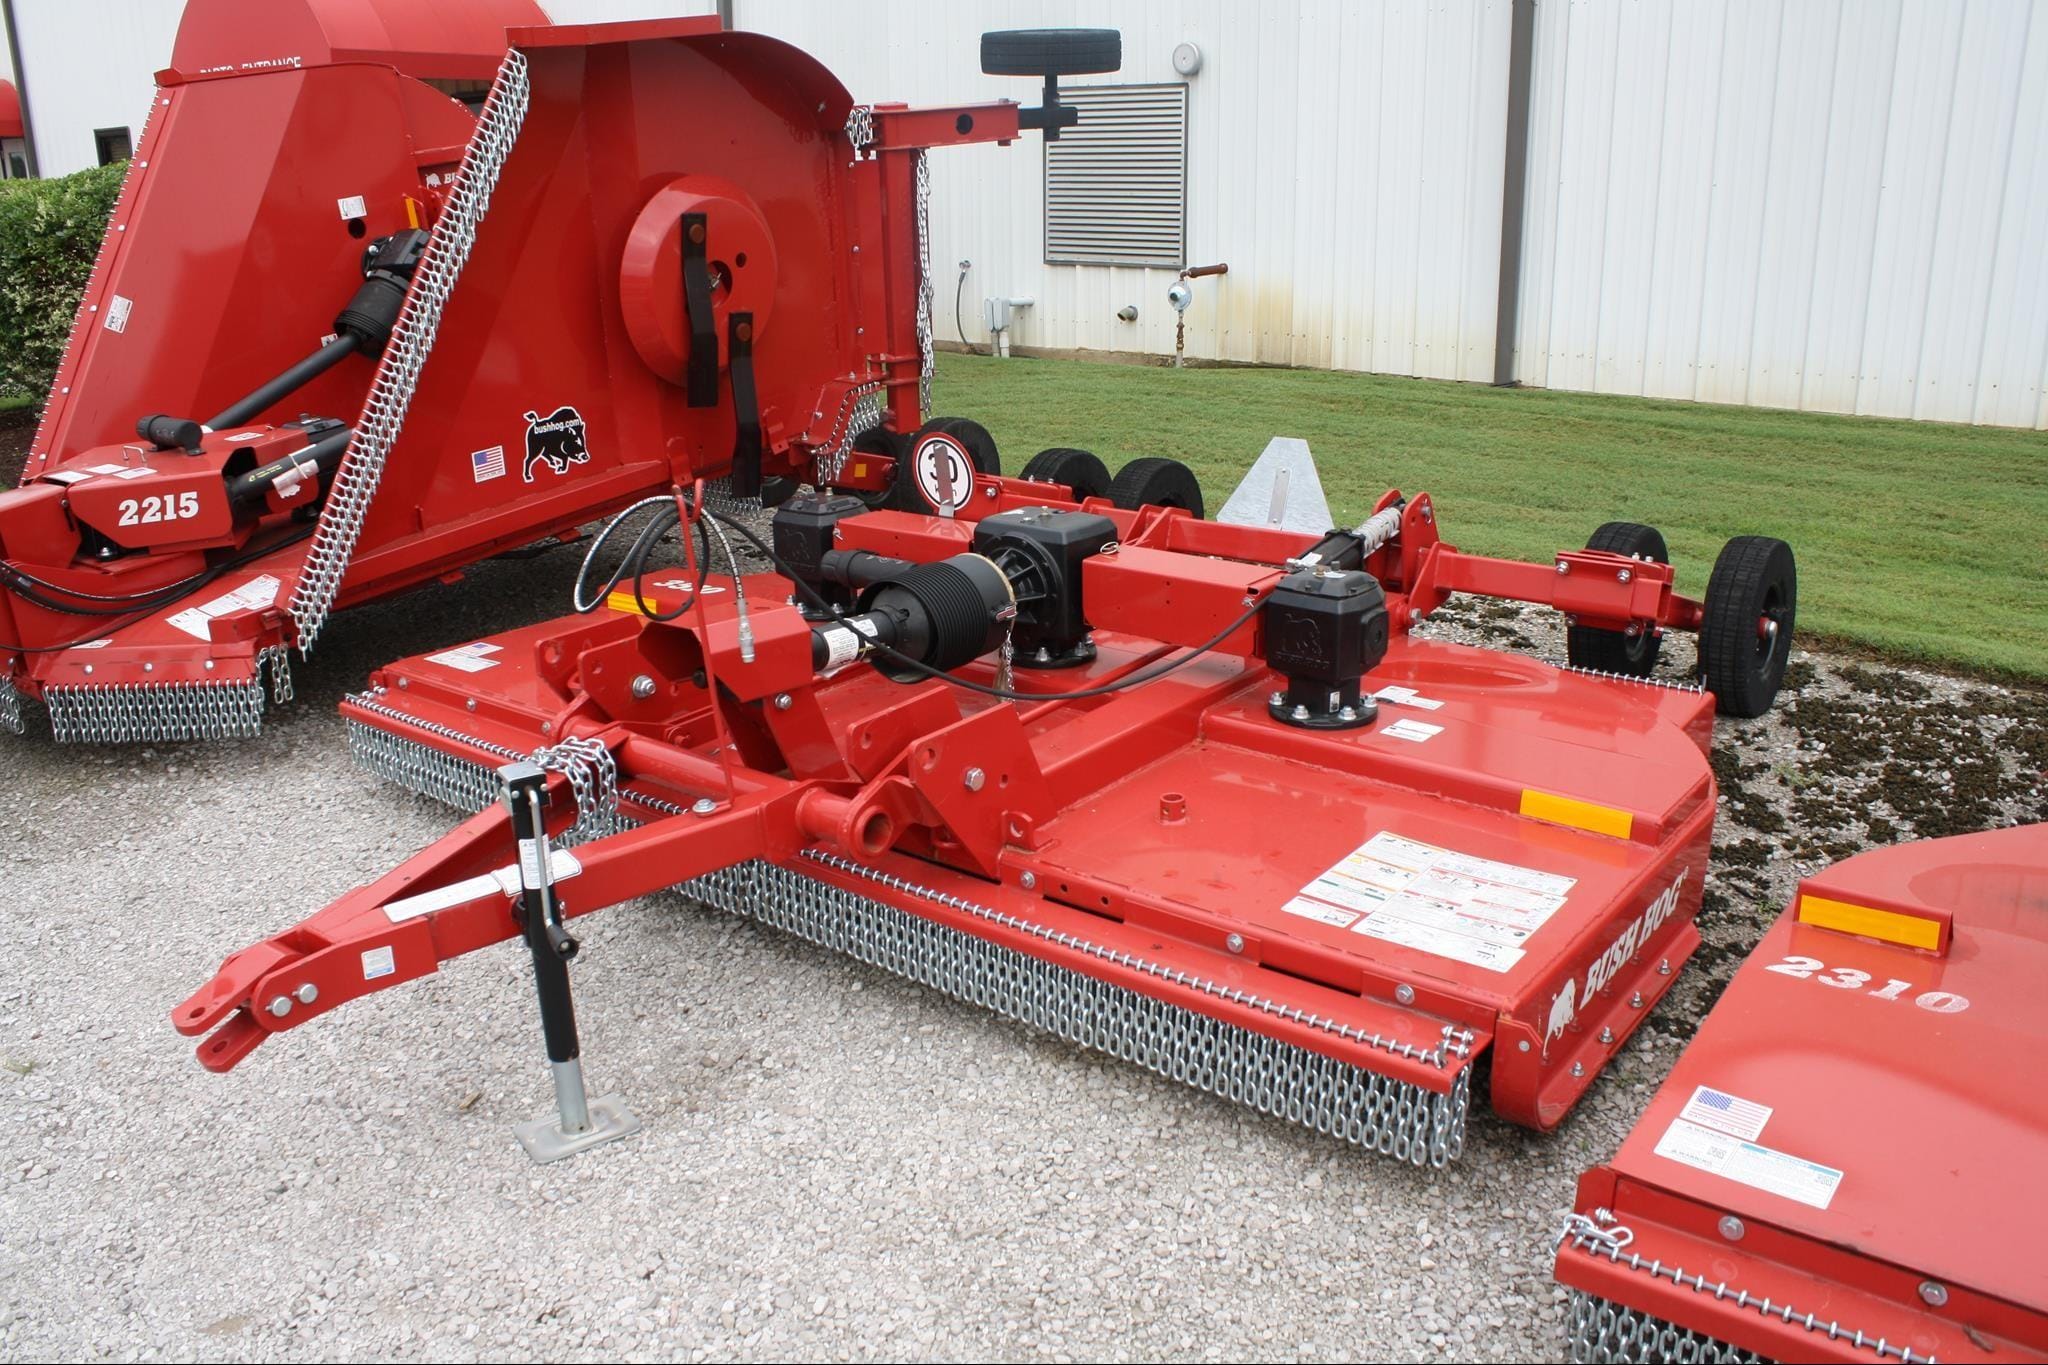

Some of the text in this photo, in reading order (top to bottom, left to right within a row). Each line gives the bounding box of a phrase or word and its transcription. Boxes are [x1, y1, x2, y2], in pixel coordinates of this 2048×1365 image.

[534, 419, 580, 435] bushhog.com
[118, 491, 199, 527] 2215
[1579, 873, 1683, 1011] BUSH HOG
[1764, 955, 1970, 1014] 2310
